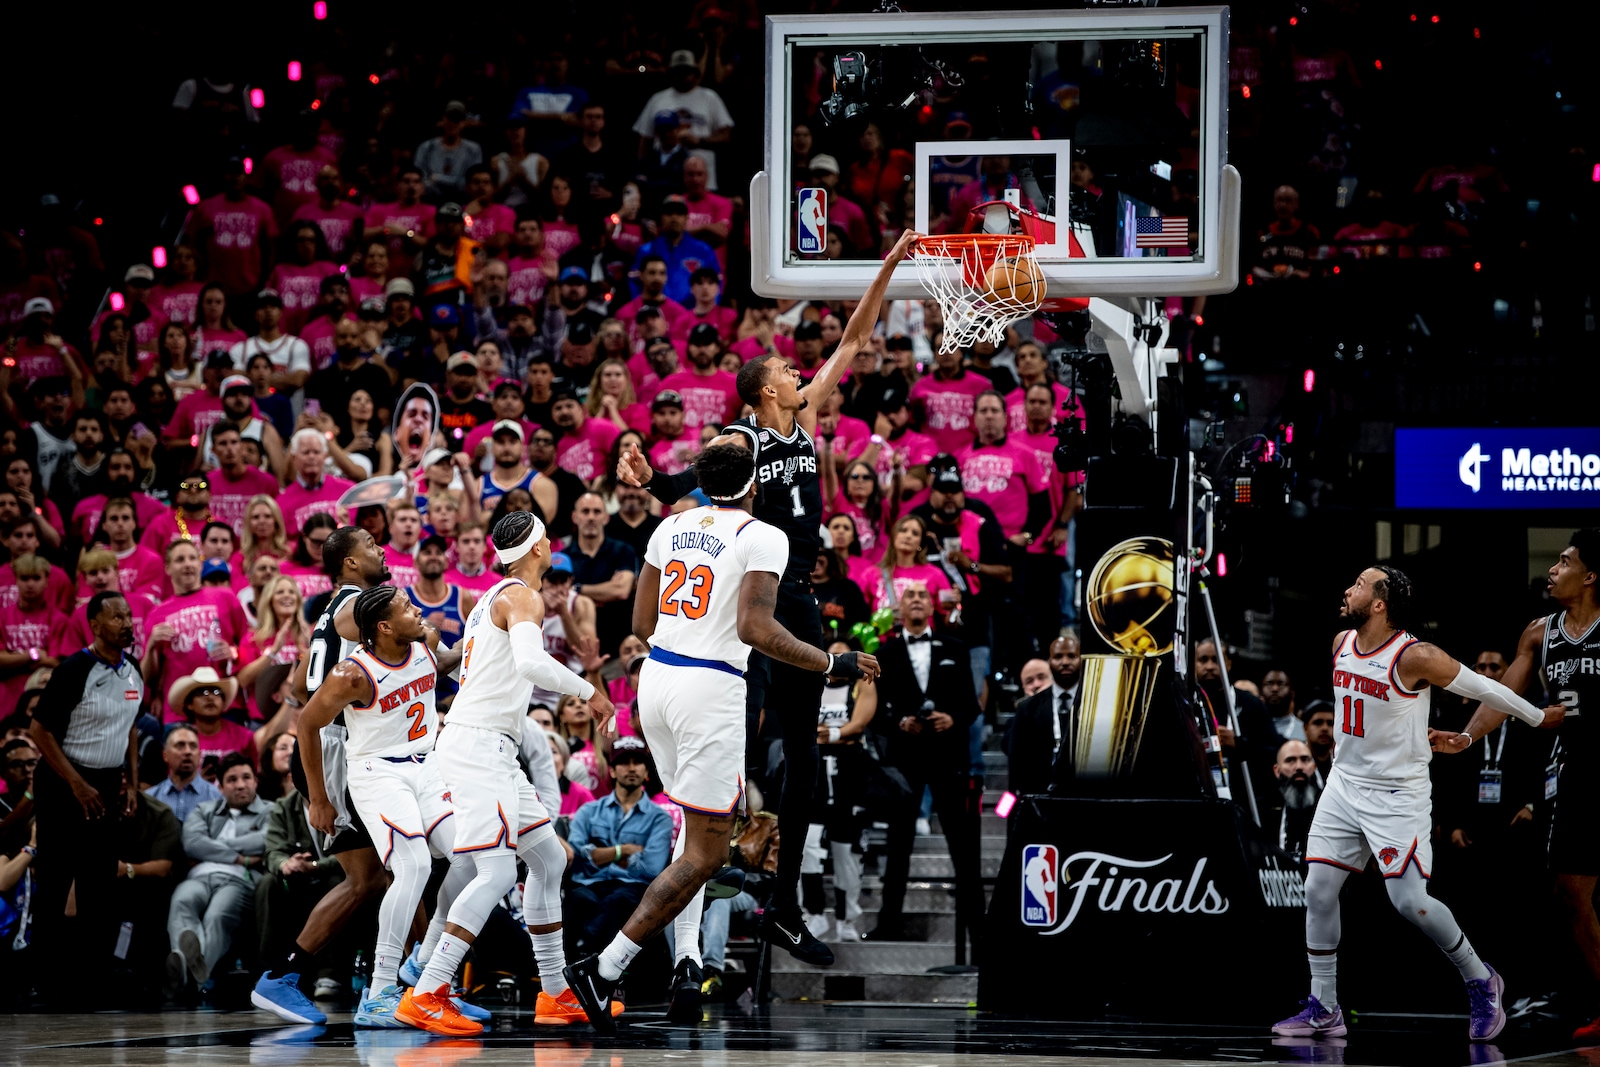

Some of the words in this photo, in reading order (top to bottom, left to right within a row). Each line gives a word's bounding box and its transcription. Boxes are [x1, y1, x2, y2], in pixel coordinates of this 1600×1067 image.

[802, 237, 816, 249] NBA
[759, 455, 817, 486] SPURS
[1501, 447, 1600, 477] Metho
[790, 485, 806, 518] 1
[672, 531, 726, 560] ROBINSON
[659, 558, 715, 621] 23
[379, 683, 410, 714] NEW
[409, 672, 436, 698] YORK
[1353, 673, 1390, 702] YORK
[1557, 689, 1581, 717] 2
[406, 701, 428, 742] 2
[1341, 695, 1365, 738] 11
[1037, 850, 1230, 936] Finals
[1026, 907, 1044, 921] NBA
